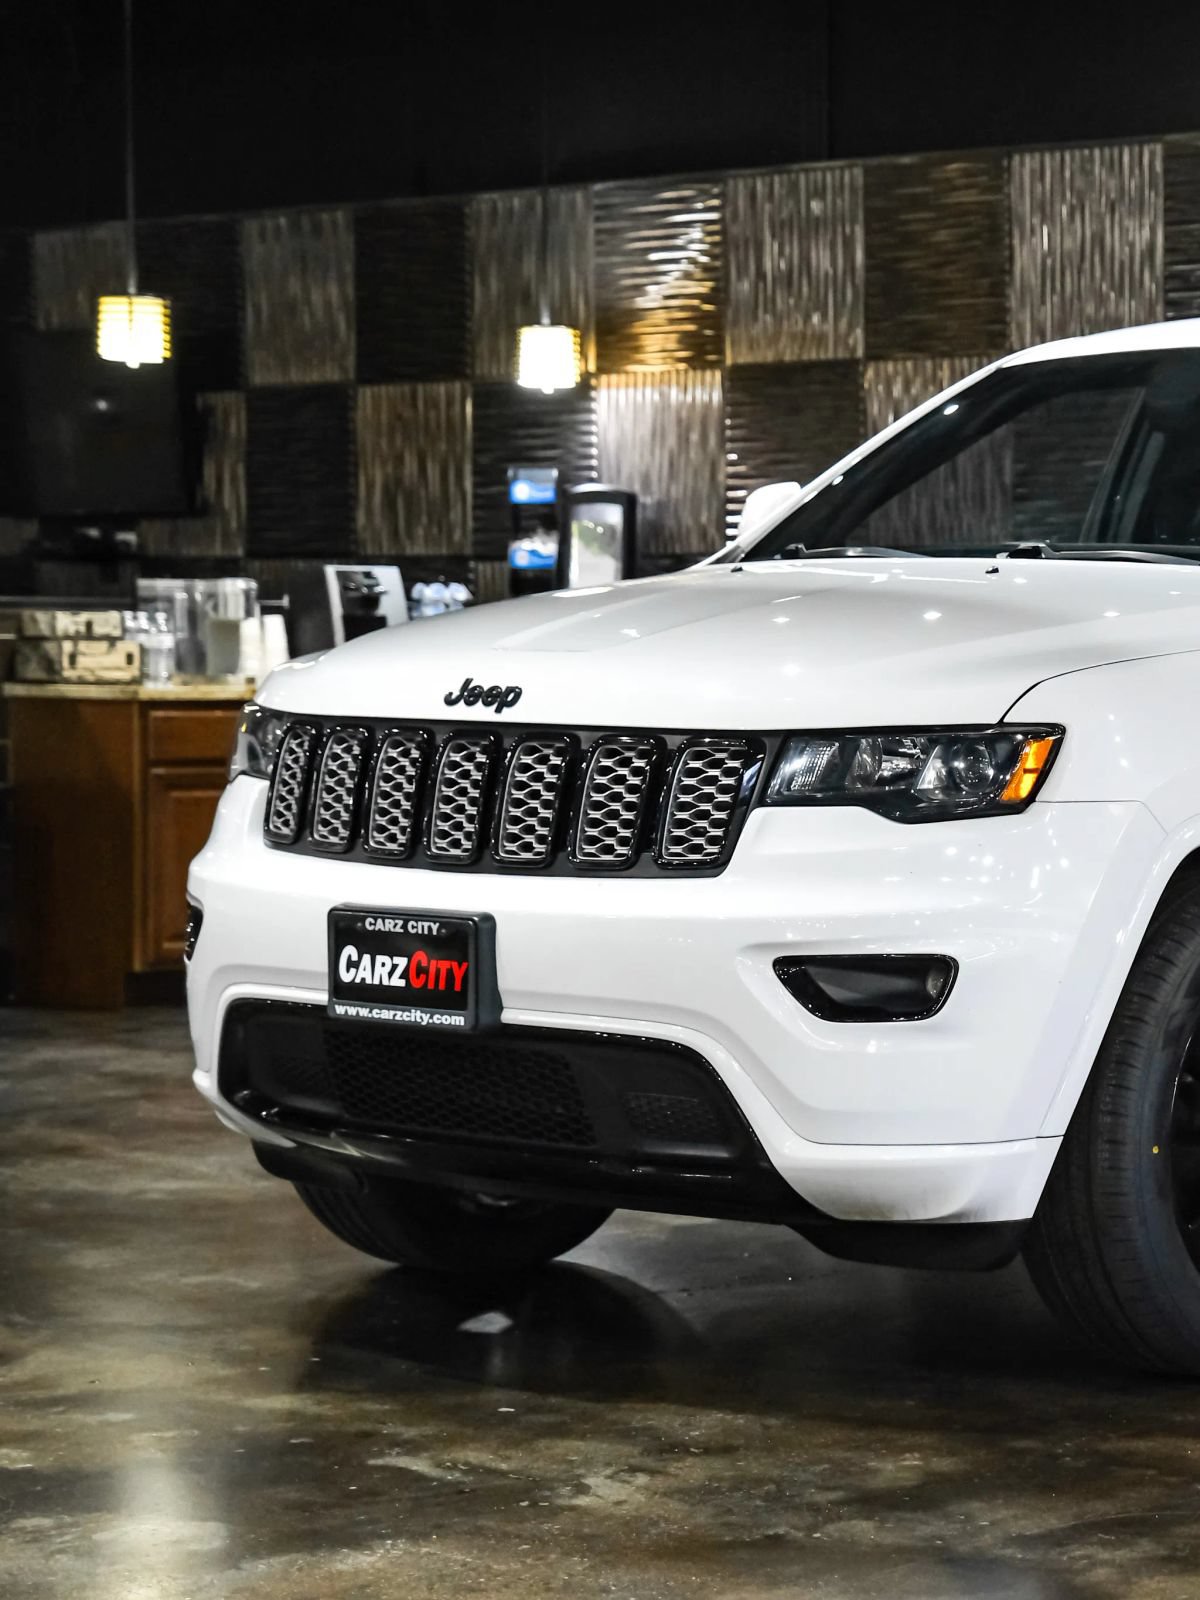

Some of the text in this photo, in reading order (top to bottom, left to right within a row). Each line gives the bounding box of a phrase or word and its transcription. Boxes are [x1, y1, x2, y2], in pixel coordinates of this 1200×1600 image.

[443, 677, 523, 714] Jeep
[365, 917, 441, 935] CARZ CITY
[334, 1004, 465, 1026] www.carzcity.com
